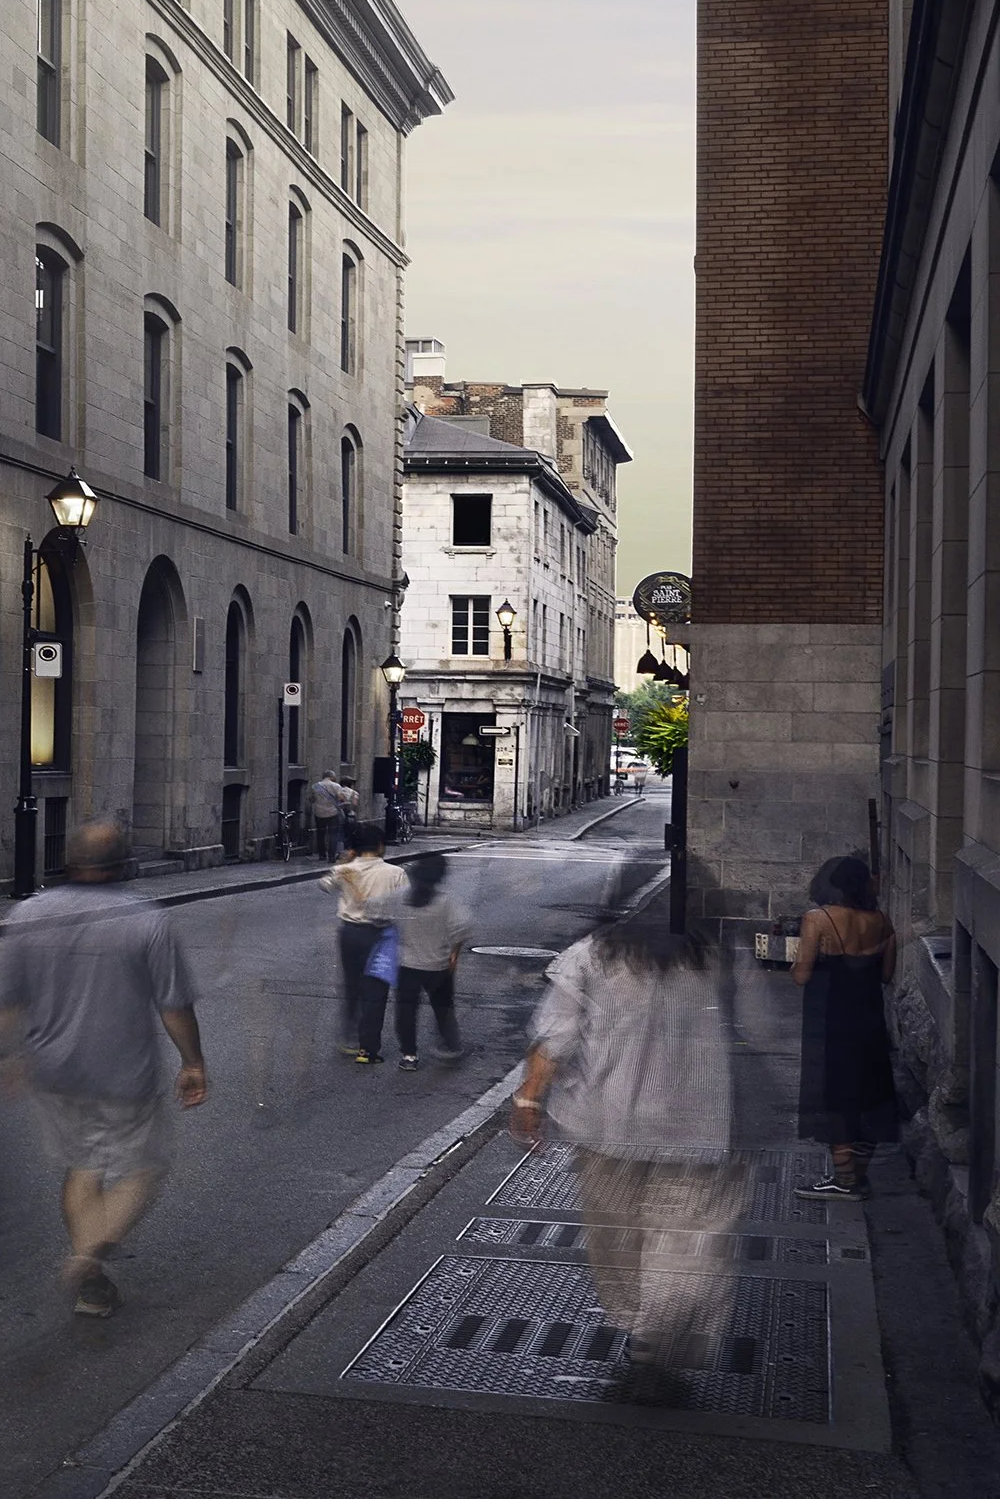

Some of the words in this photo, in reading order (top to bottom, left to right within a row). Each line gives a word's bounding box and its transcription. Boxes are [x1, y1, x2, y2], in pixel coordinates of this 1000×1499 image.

[653, 589, 681, 597] SAINT
[651, 596, 683, 604] PIERRE
[403, 715, 424, 723] RRÊT
